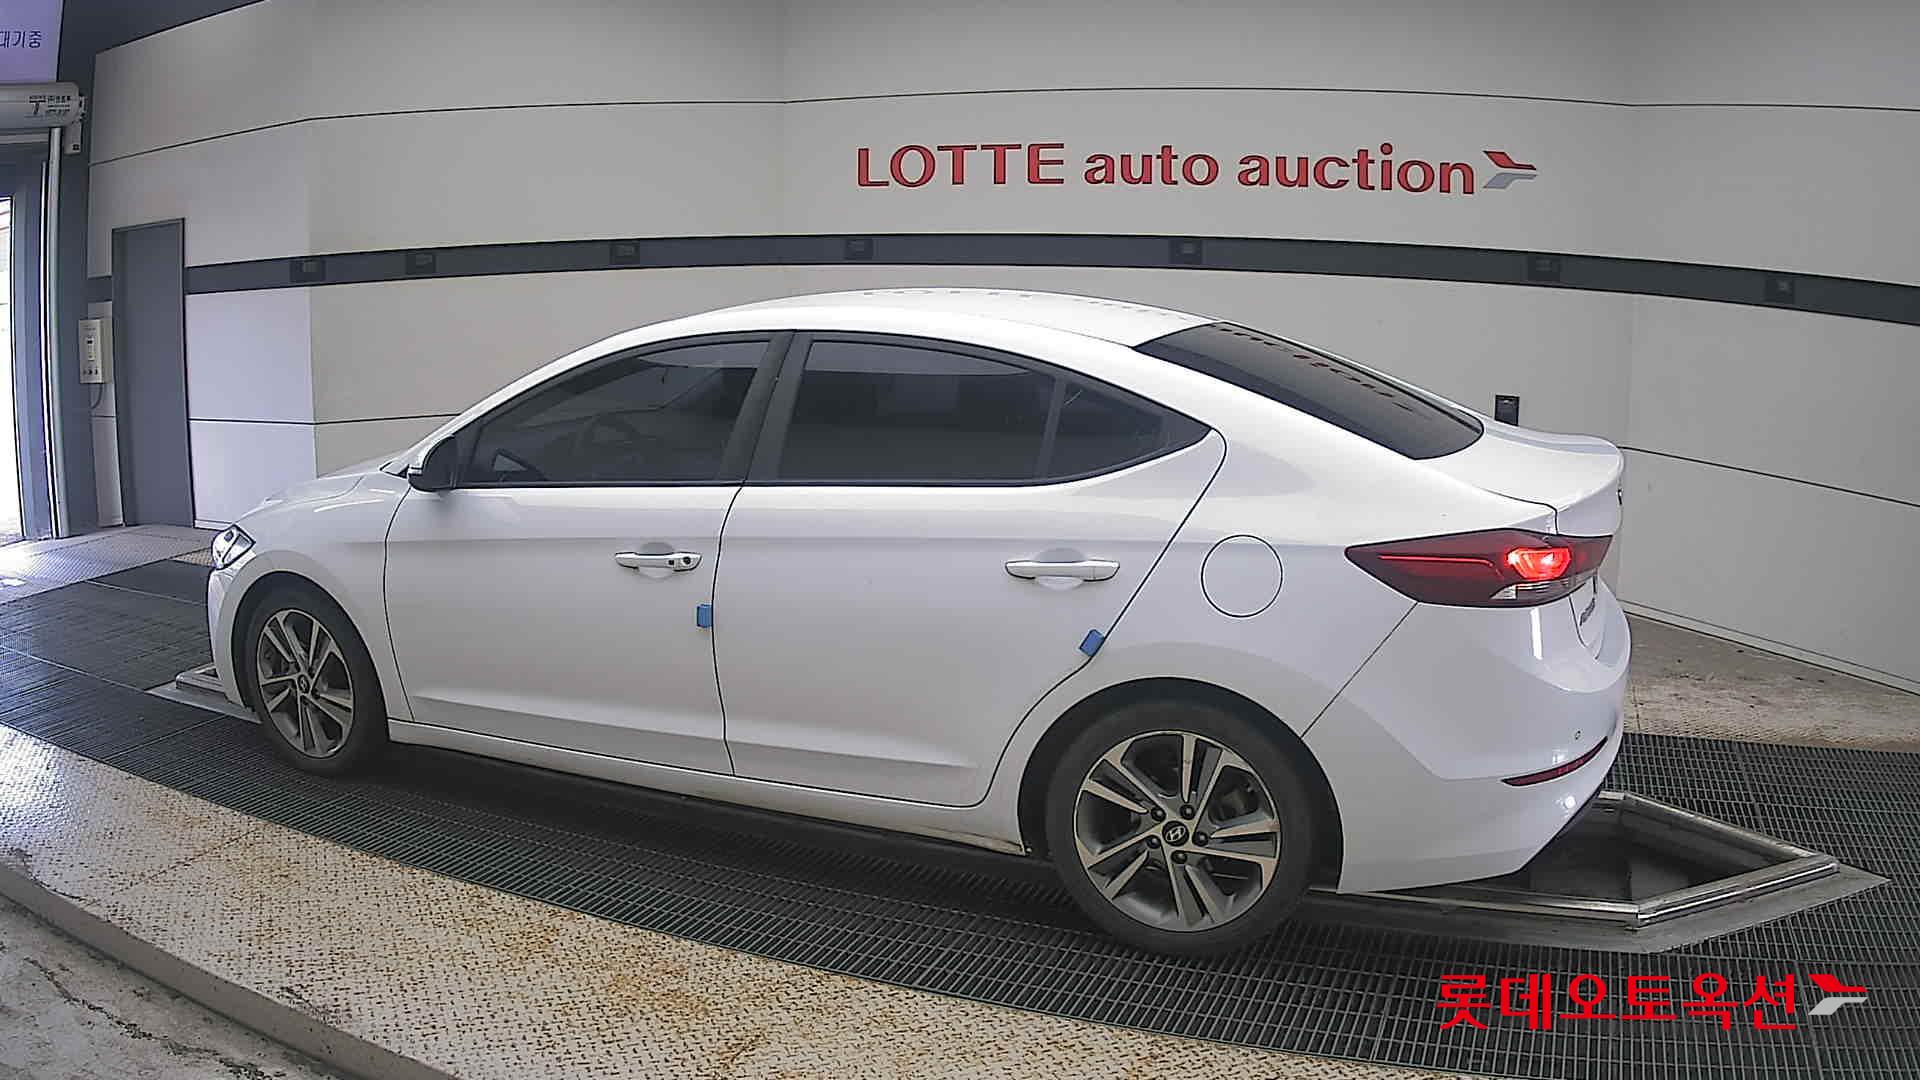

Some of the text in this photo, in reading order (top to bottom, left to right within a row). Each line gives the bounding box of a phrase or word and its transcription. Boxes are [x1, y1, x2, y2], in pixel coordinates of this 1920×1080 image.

[857, 142, 1476, 195] LOTTE auto auction
